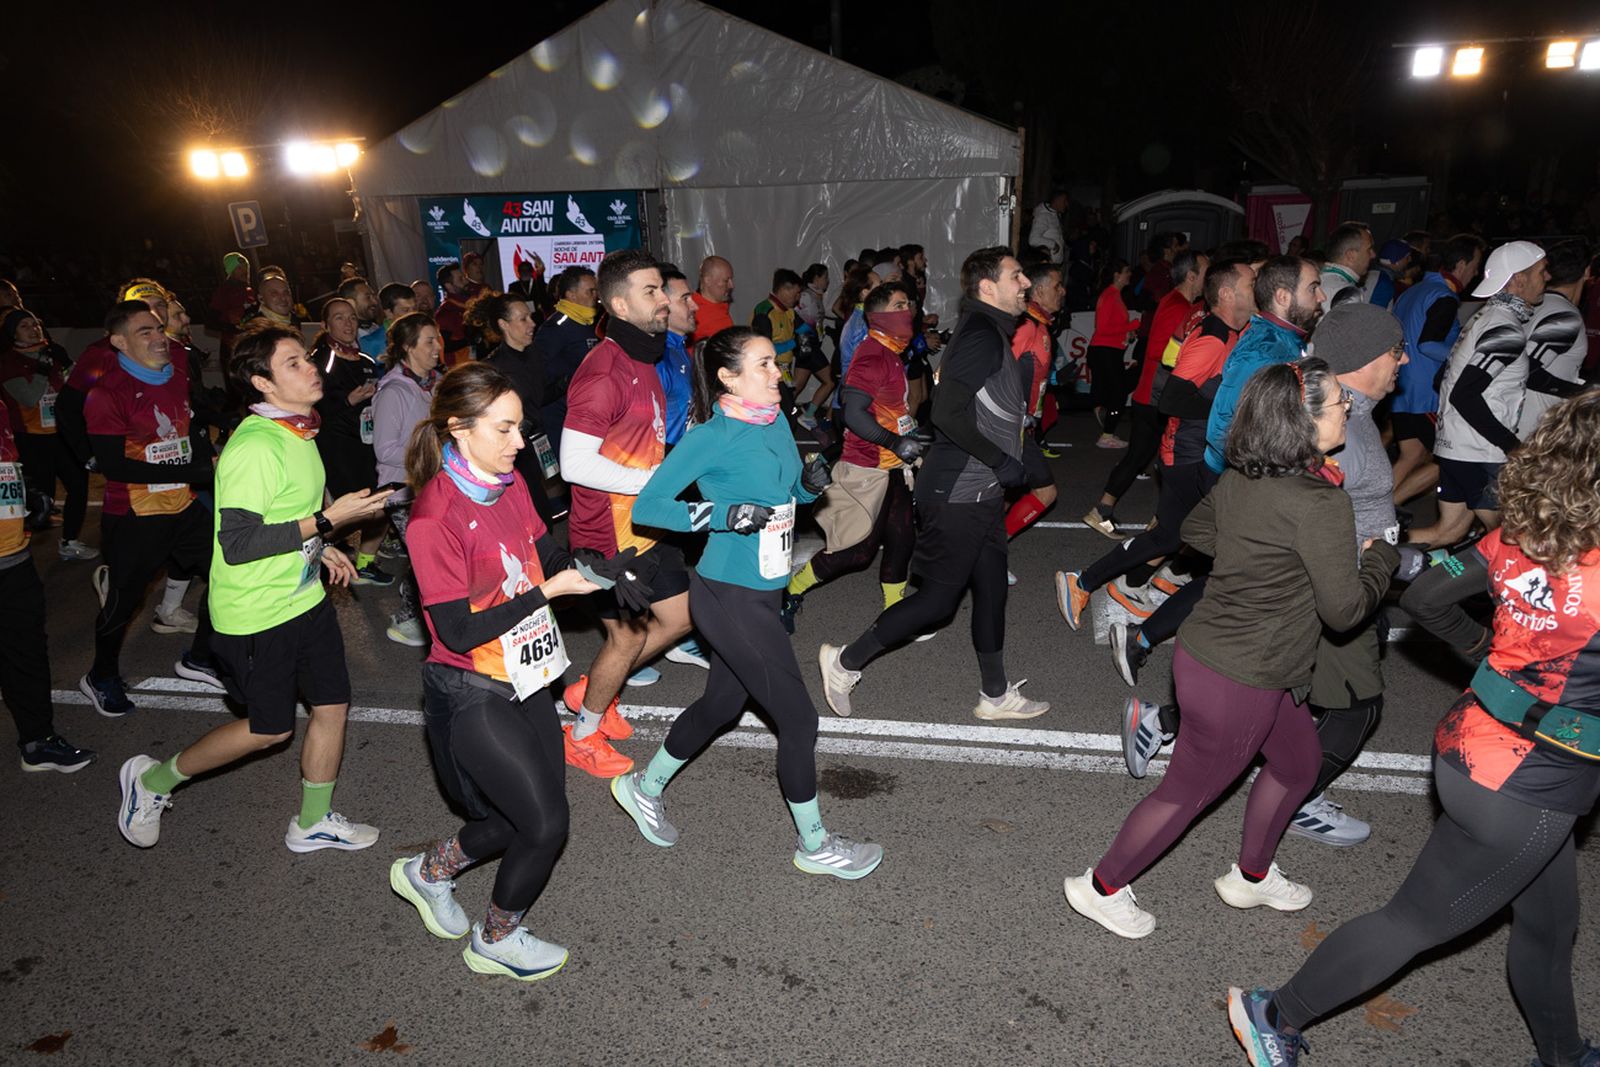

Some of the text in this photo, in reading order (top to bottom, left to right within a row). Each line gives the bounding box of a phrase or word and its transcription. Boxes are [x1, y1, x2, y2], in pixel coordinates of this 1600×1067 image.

[502, 200, 554, 218] 43 SAN
[237, 207, 257, 242] P
[501, 213, 553, 233] ANTÓN
[575, 216, 586, 228] 43
[553, 251, 605, 264] SAN ANT
[519, 617, 541, 633] NOCHE
[512, 634, 528, 647] SAN
[520, 626, 559, 666] 4634
[1261, 1033, 1284, 1066] HOKA
